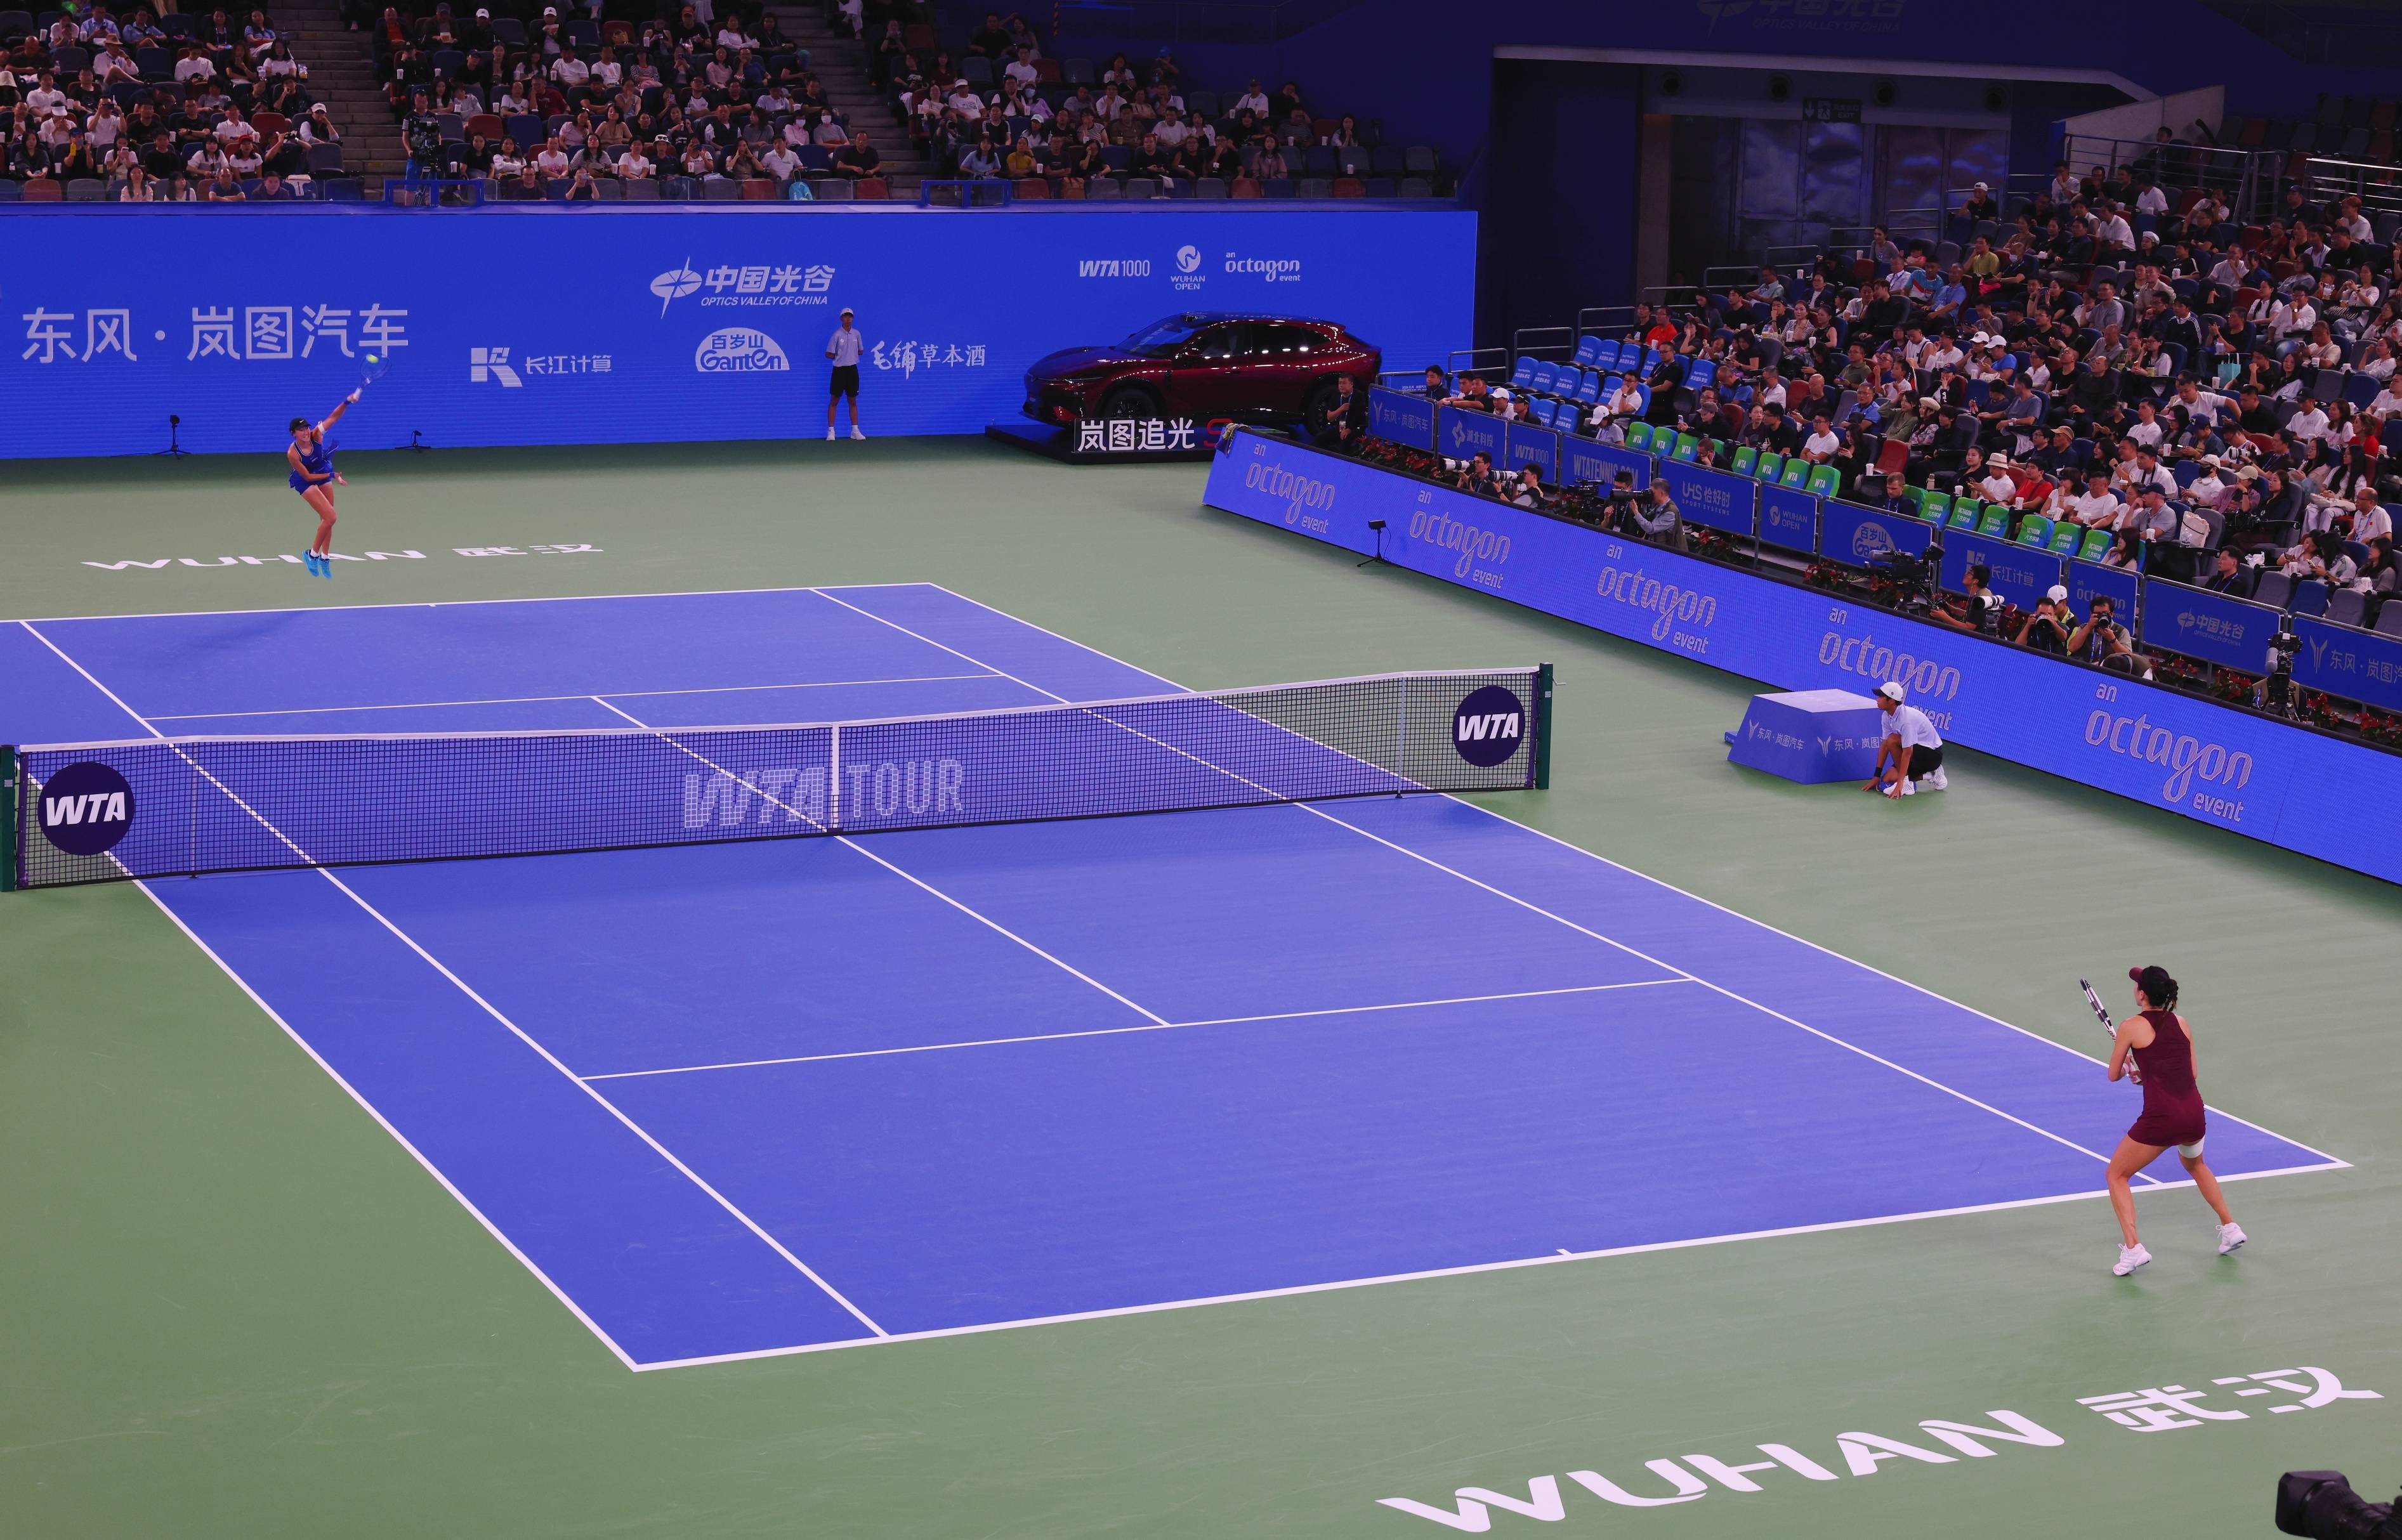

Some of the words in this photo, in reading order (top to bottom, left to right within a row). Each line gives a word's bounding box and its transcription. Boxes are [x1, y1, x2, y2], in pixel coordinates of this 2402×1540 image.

[706, 265, 835, 293] 中国光谷
[1225, 259, 1301, 282] octagon
[701, 297, 738, 306] OPTICS
[740, 296, 778, 306] VALLEY
[779, 296, 794, 306] OF
[794, 296, 827, 305] CHINA
[22, 304, 408, 363] 东风·岚图汽车
[710, 332, 765, 350] 百岁山
[525, 355, 611, 374] 长江计算
[701, 349, 782, 371] Ganten
[1078, 417, 1195, 452] 岚图追光
[1632, 435, 1642, 444] WTA
[1254, 444, 1266, 456] an
[1656, 440, 1665, 449] WTA
[1681, 445, 1691, 454] WTA
[1574, 454, 1639, 490] WTATENNISM
[1736, 459, 1747, 468] WTA
[1762, 464, 1772, 475] WTA
[1787, 472, 1798, 482] WTA
[1815, 478, 1826, 489] WTA
[1245, 463, 1336, 524] octagon
[1419, 490, 1431, 504] an
[1704, 486, 1731, 508] 恰好时
[1683, 499, 1701, 508] SPORT
[1929, 504, 1943, 512] OCTAGON
[1958, 507, 1972, 516] OCTAGON
[1302, 516, 1329, 533] event
[1782, 510, 1808, 523] WUHAN
[1782, 520, 1800, 530] OPEN
[1987, 516, 2000, 526] OCTAGON
[1860, 526, 1887, 543] 百岁山
[2026, 527, 2040, 535] OCTAGON
[2057, 533, 2072, 542] OCTAGON
[452, 544, 604, 556] 武汉
[1409, 511, 1511, 578] octagon
[1607, 544, 1622, 559] an
[2089, 543, 2103, 552] OCTAGON
[1473, 569, 1504, 589] event
[1991, 564, 2034, 587] 长江计算
[1598, 567, 1716, 641] octagon
[2077, 589, 2125, 610] octn
[1829, 608, 1847, 624] an
[2112, 610, 2125, 621] vent
[2196, 615, 2245, 639] 中国光谷
[1673, 632, 1709, 655] event
[1818, 632, 1960, 703] octagon
[2096, 683, 2117, 702] an
[1459, 713, 1518, 741] WTA
[1757, 727, 1805, 751] 东风·岚图汽车
[1834, 735, 1882, 752] 东风·岚图
[2085, 710, 2253, 803] octagon
[684, 766, 825, 828] WTA
[846, 759, 963, 818] TOUR
[46, 792, 125, 826] WTA
[2193, 792, 2244, 823] event
[1375, 1410, 2064, 1532] WUHAN
[2075, 1367, 2384, 1432] 武汉
